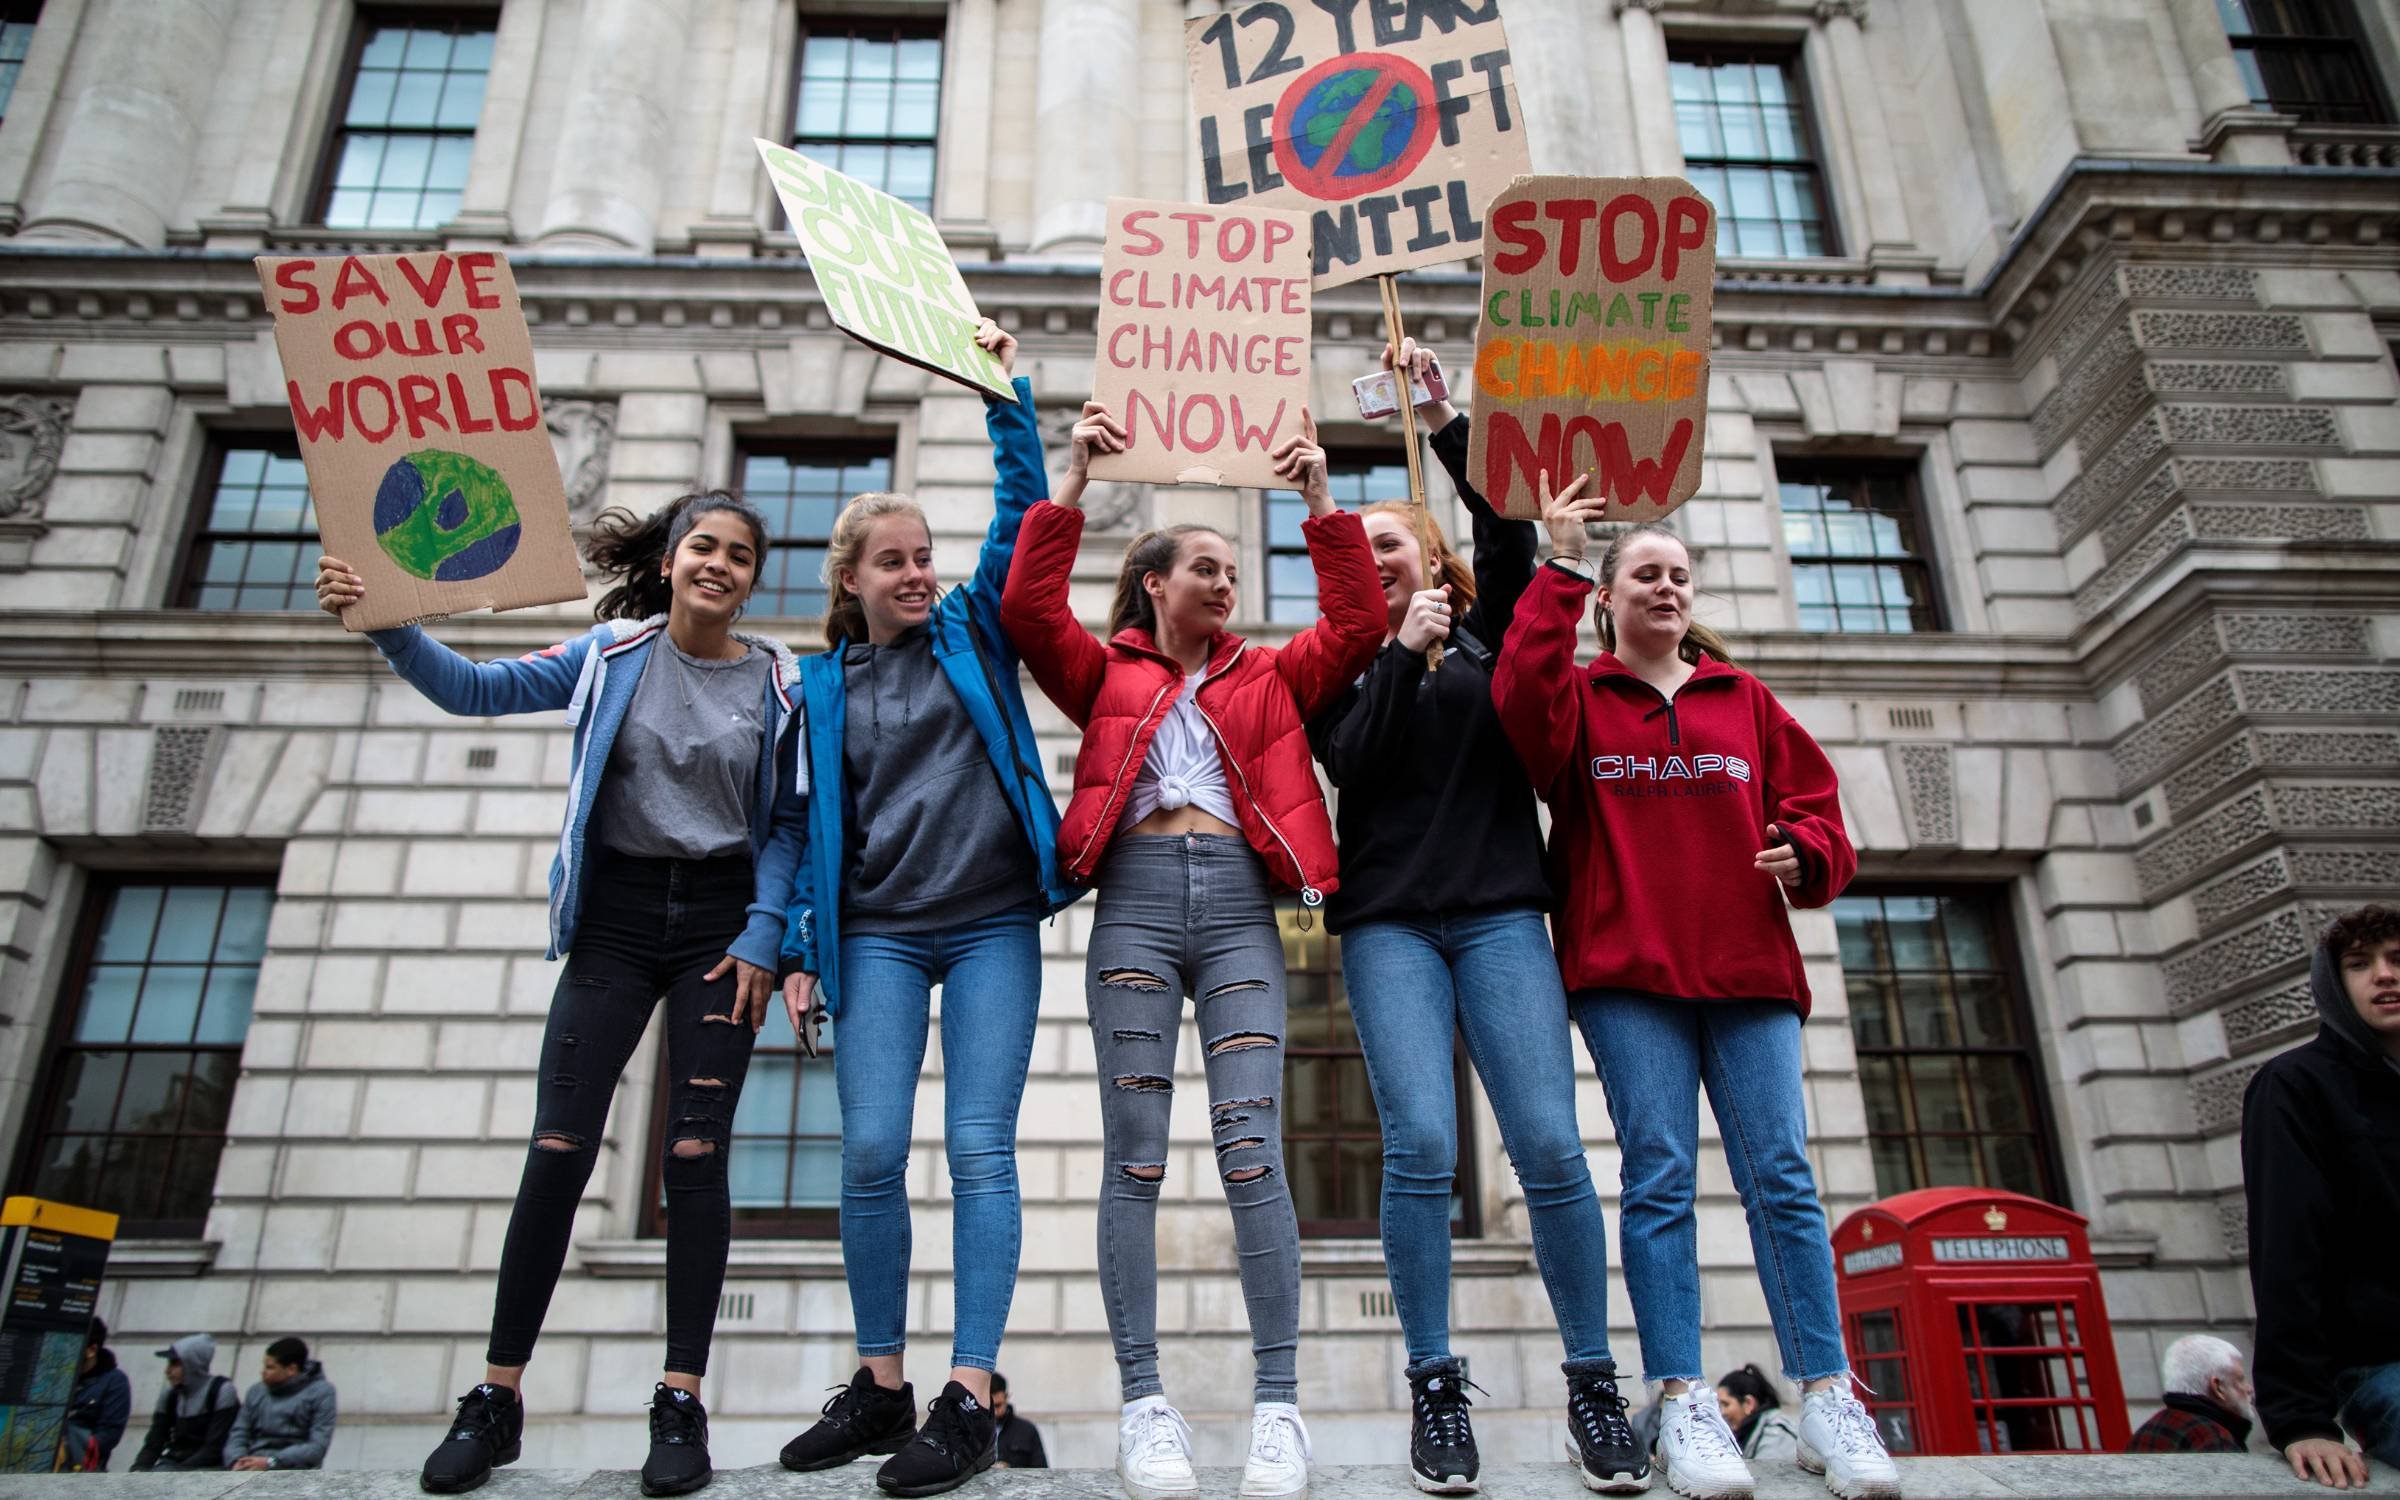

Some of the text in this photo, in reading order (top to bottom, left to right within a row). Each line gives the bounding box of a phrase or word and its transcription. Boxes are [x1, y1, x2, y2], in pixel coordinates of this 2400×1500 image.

[1201, 2, 1305, 89] 12
[766, 147, 952, 266] SAVE
[1121, 210, 1294, 264] STOP
[1312, 180, 1483, 275] NTIL
[1492, 194, 1709, 283] STOP
[275, 252, 501, 315] SAVE
[802, 206, 967, 314] OUR
[1109, 268, 1309, 314] CLIMATE
[333, 313, 485, 361] OUR
[810, 254, 1013, 398] FUTURE
[1487, 288, 1692, 333] CLIMATE
[1107, 322, 1305, 376] CHANGE
[1474, 338, 1701, 404] CHANGE
[287, 367, 540, 444] WORLD
[1124, 388, 1287, 453] NOW
[1485, 411, 1694, 514] NOW
[1591, 754, 1751, 783] CHAPS
[1613, 781, 1738, 798] RALPH LAUREN
[1935, 1238, 2067, 1260] TELEPHONE
